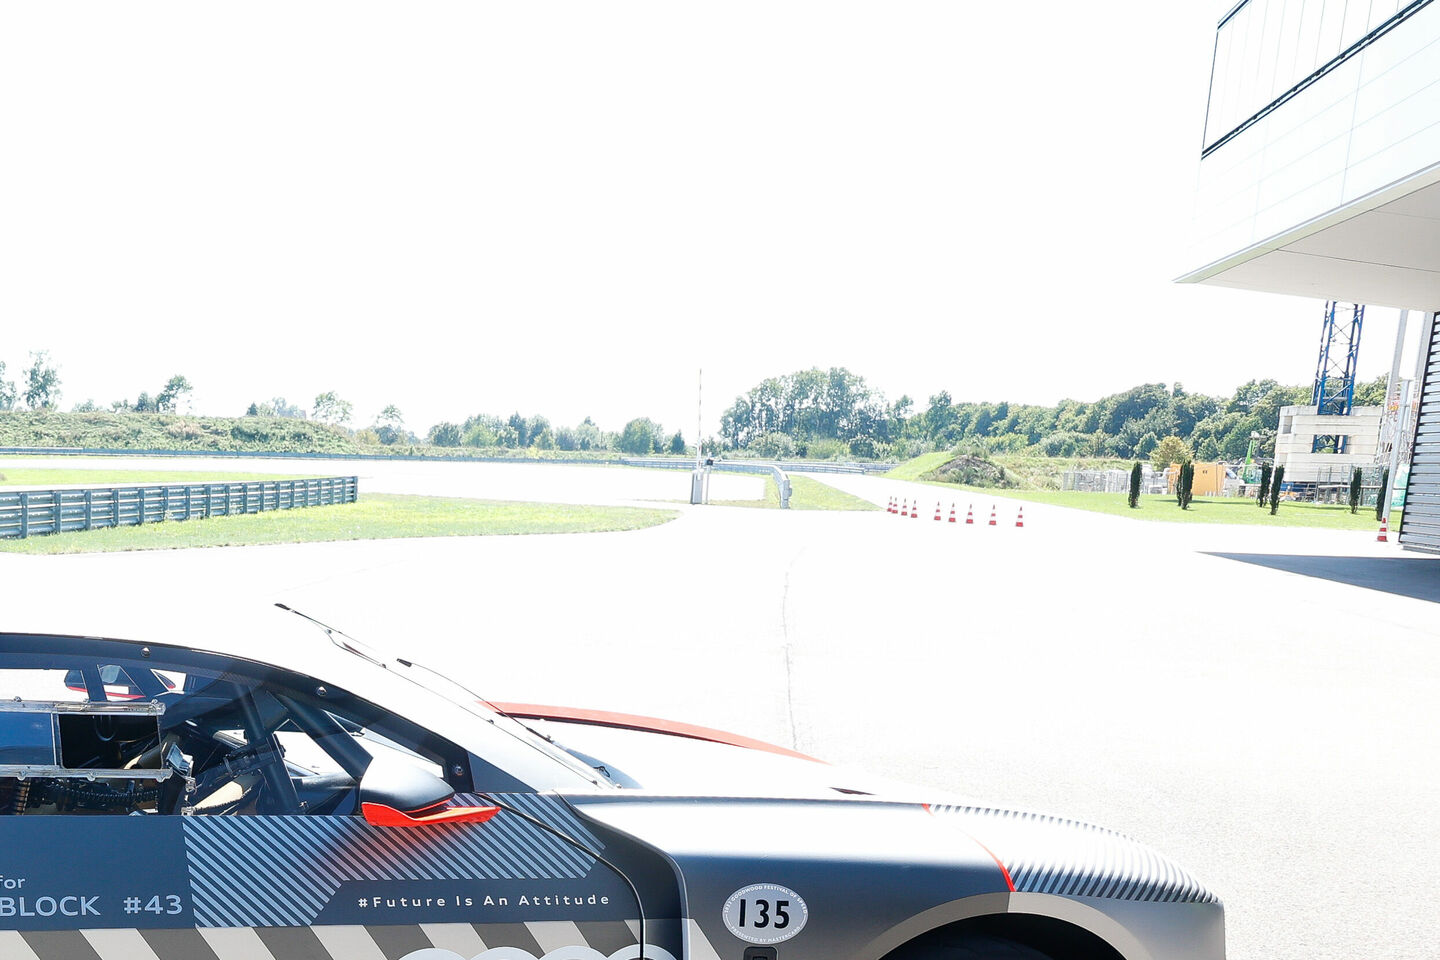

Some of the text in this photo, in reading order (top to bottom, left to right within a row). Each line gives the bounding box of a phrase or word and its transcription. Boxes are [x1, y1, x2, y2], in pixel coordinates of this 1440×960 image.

[123, 895, 183, 915] #43
[358, 894, 609, 908] #Future Is An Attitude
[731, 885, 763, 902] GOODWOOD
[763, 885, 789, 895] FESTIVAL
[789, 891, 798, 899] OF
[796, 897, 808, 914] SPEED
[738, 899, 790, 930] 135
